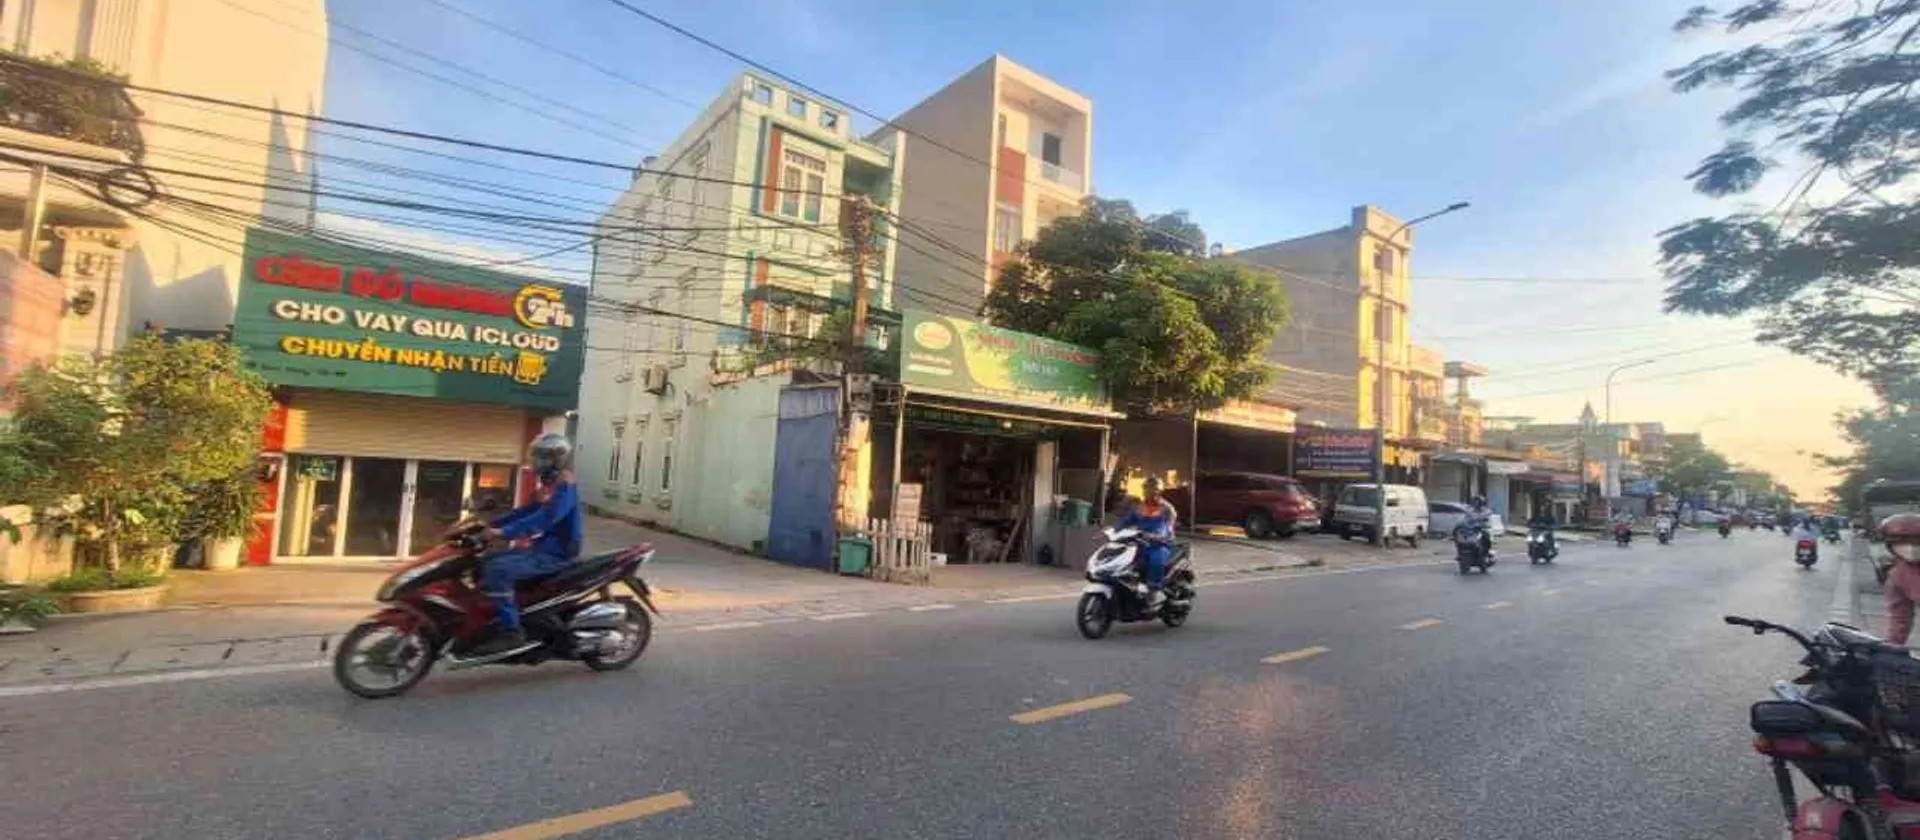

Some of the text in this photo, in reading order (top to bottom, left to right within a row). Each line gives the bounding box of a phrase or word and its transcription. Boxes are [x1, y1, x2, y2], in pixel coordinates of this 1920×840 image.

[275, 299, 560, 351] CHO VAY QUA ICLOUD
[396, 348, 464, 373] NHẬN
